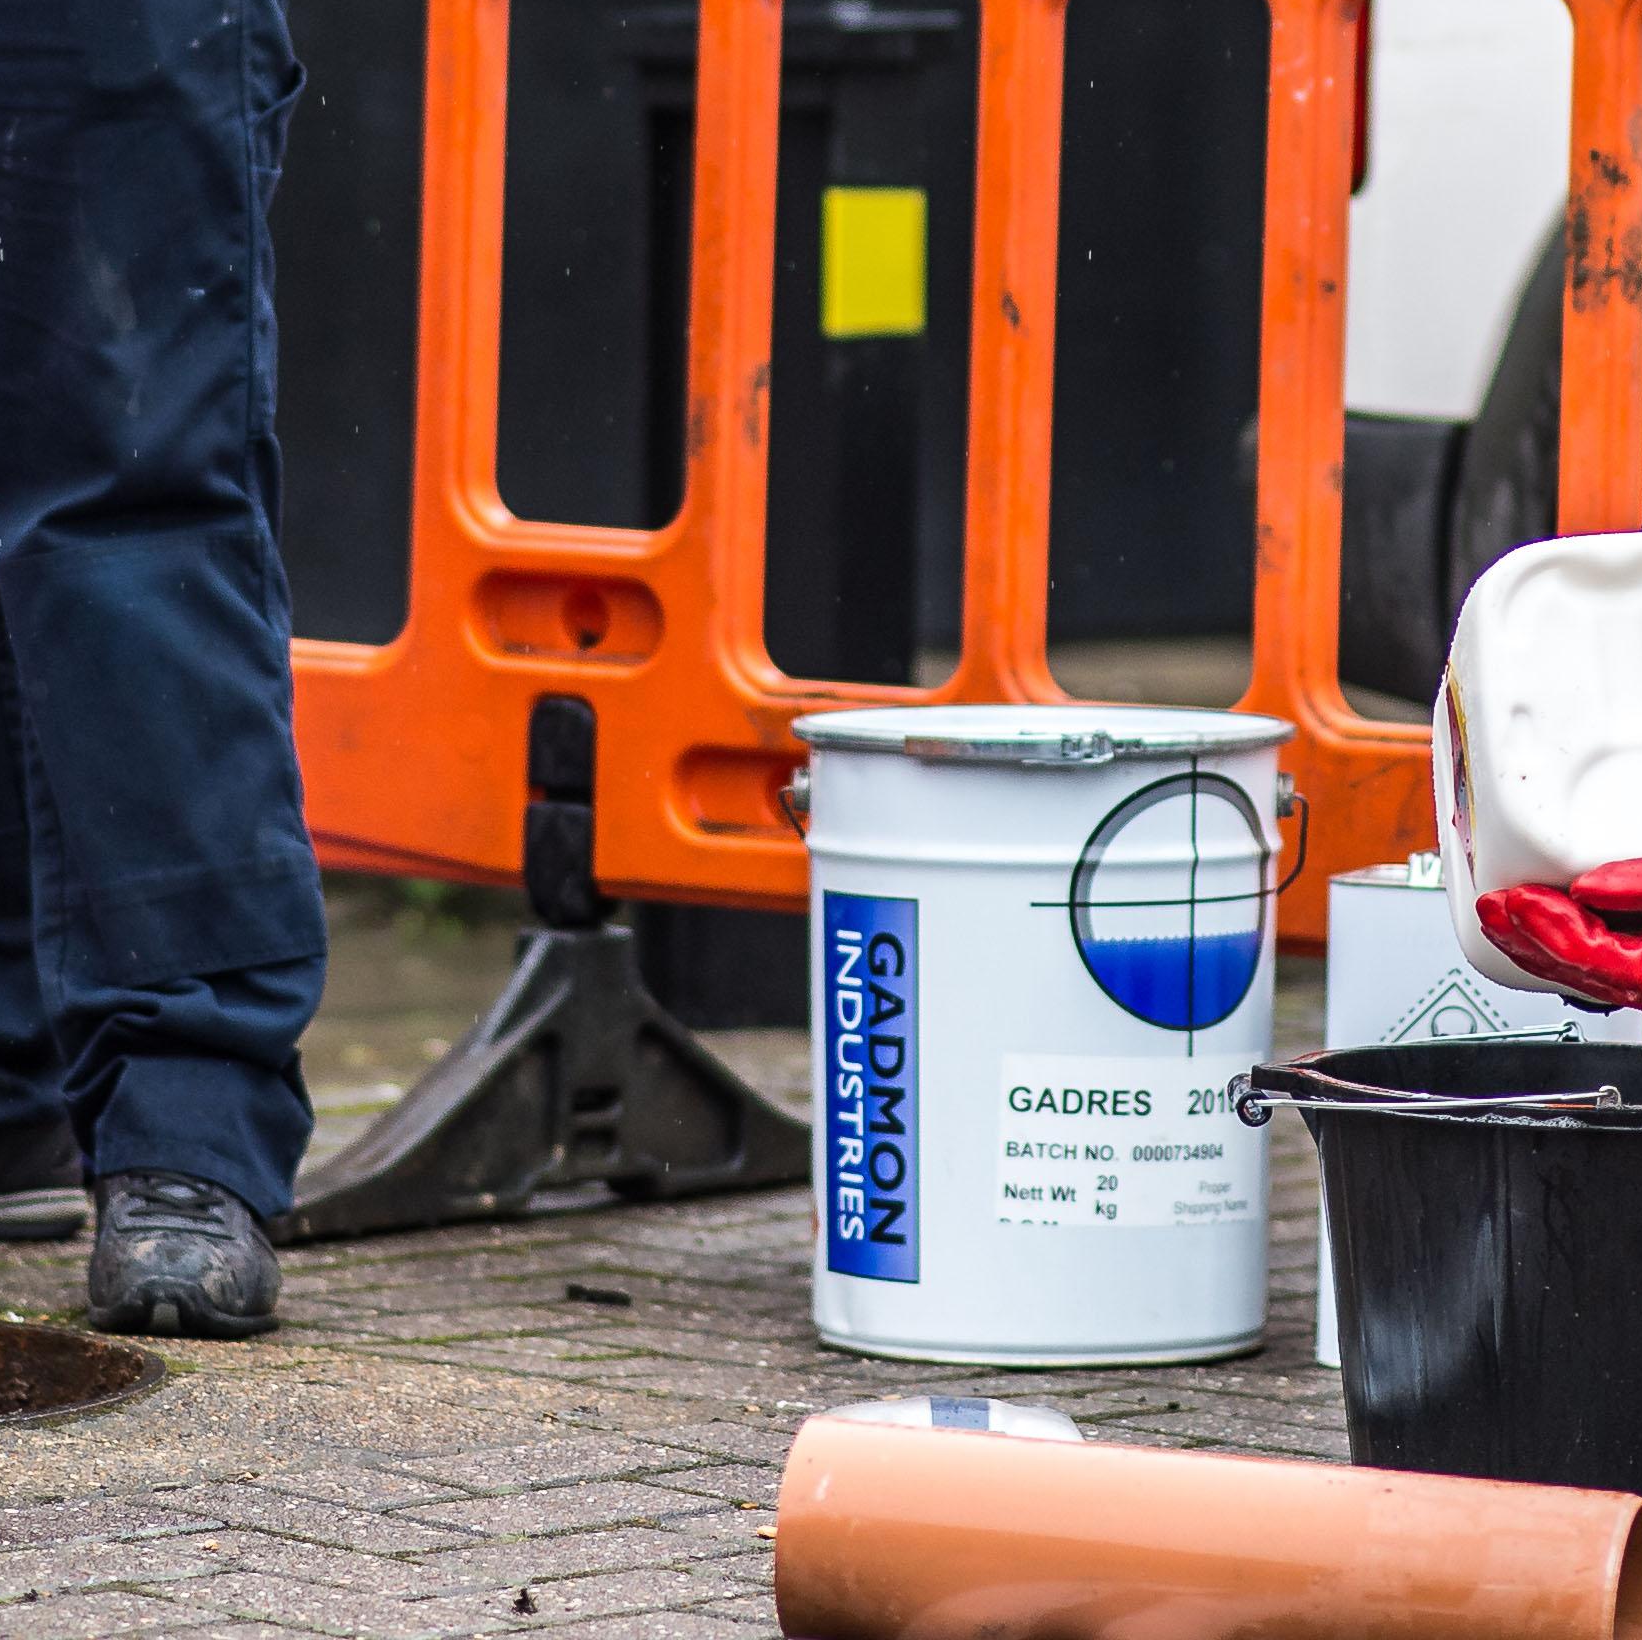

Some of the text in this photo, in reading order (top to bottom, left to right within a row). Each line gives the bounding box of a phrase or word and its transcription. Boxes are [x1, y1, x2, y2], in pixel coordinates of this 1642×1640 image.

[835, 928, 866, 1241] INDUSTRIES
[867, 930, 906, 1245] GADMON
[1008, 1085, 1153, 1117] GADRES
[1005, 1140, 1078, 1161] BATCH
[1084, 1143, 1119, 1162] NO.
[1003, 1182, 1077, 1203] Nett Wt
[1095, 1173, 1119, 1193] 20
[1094, 1199, 1118, 1221] kg
